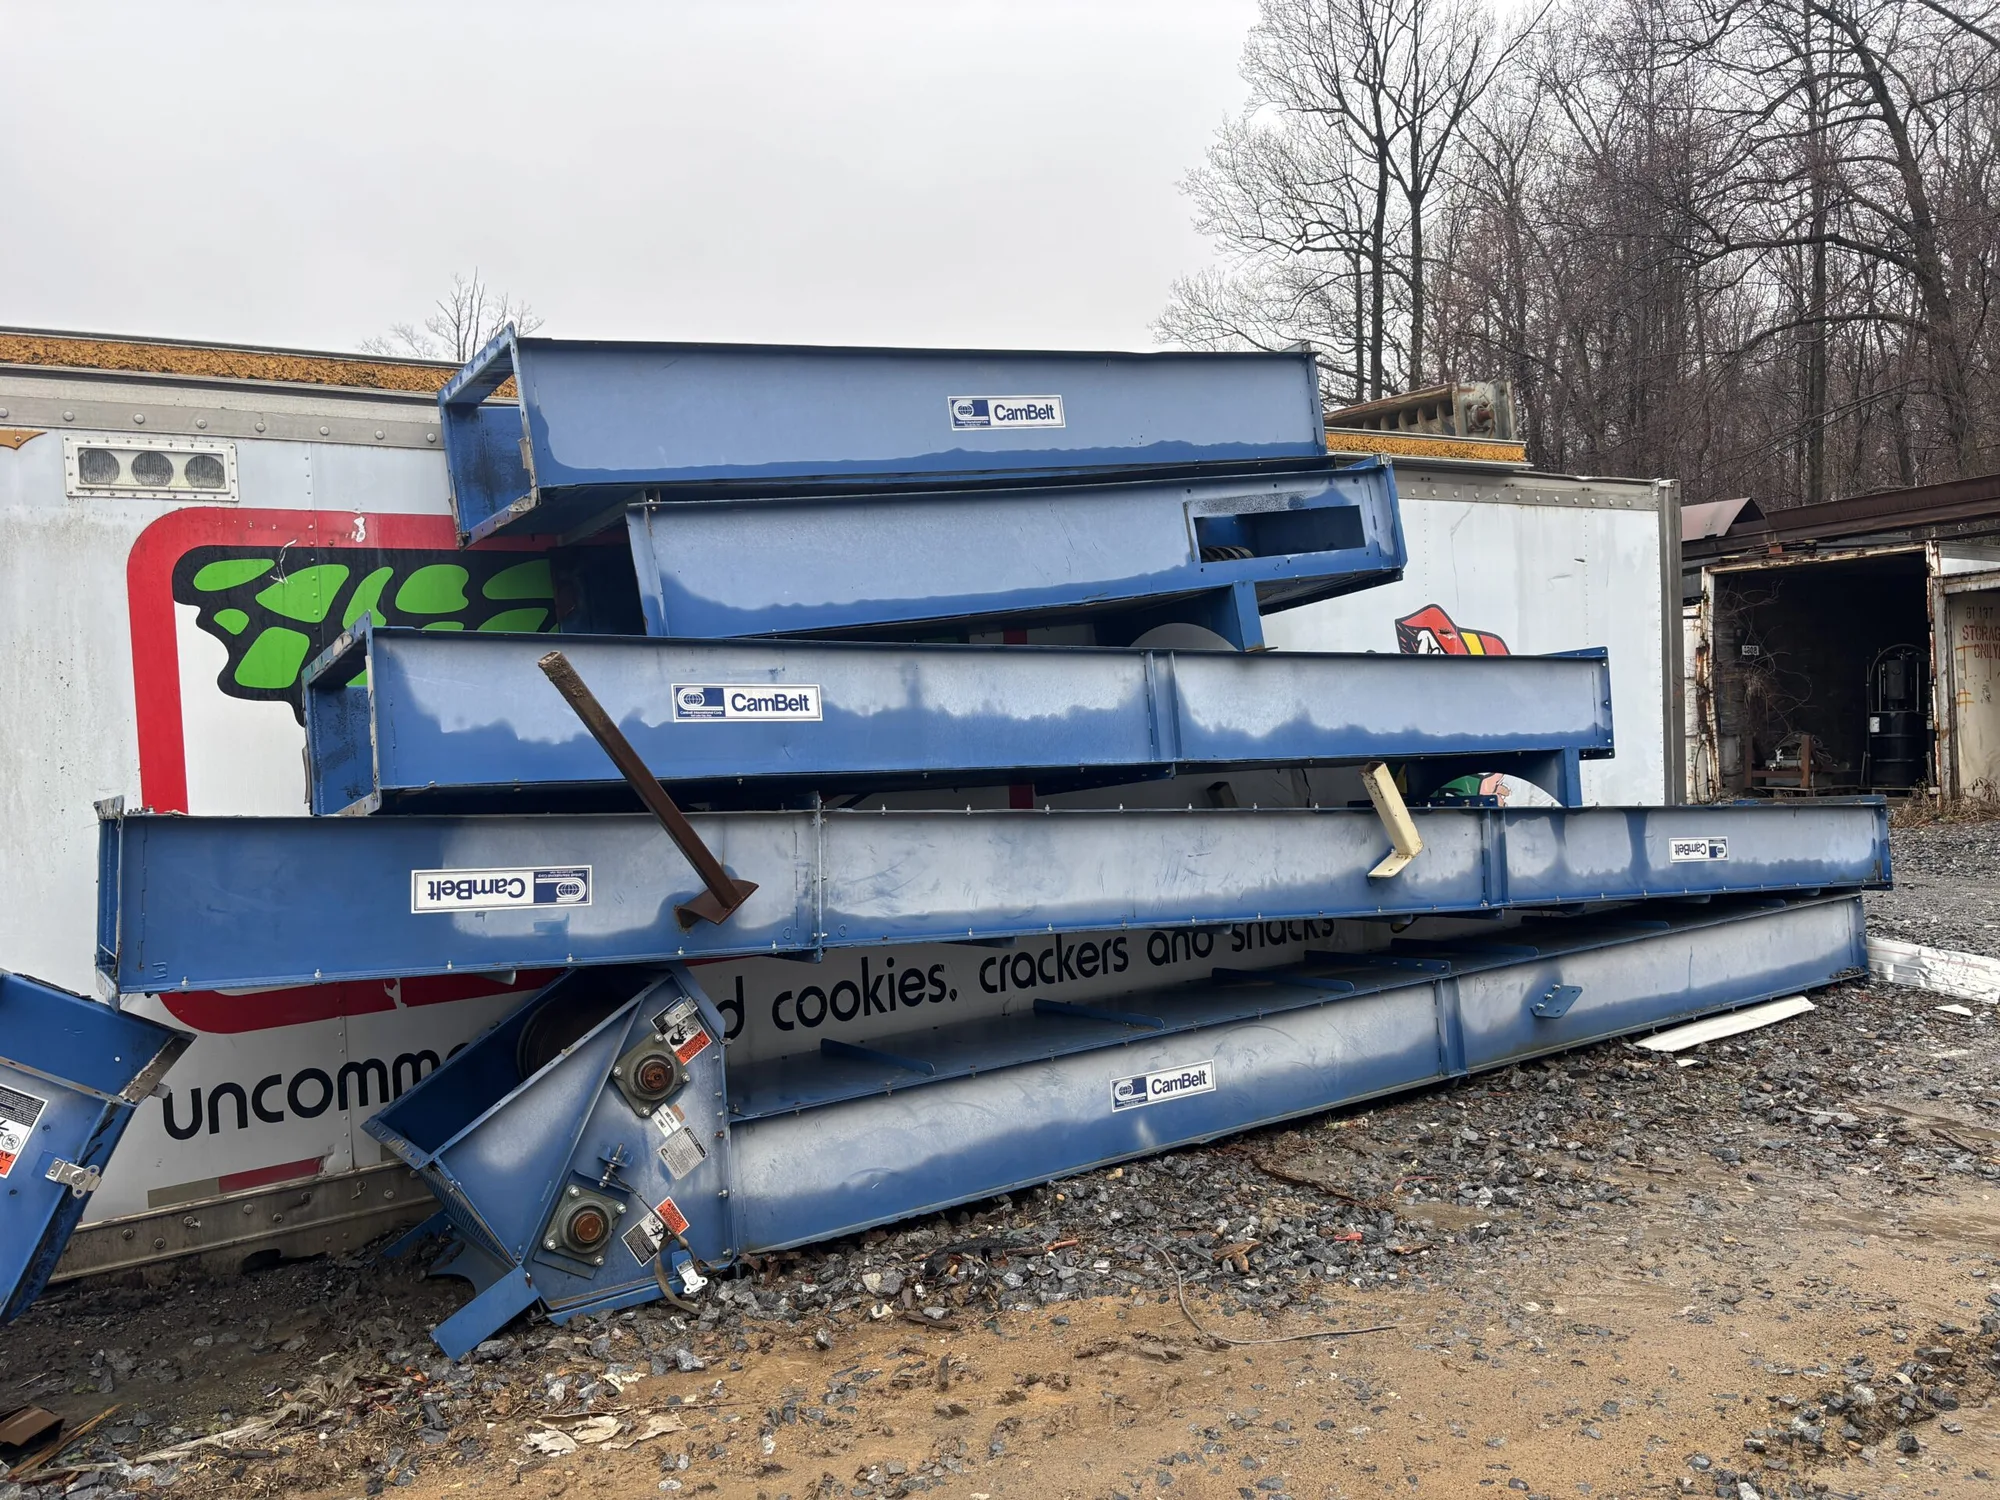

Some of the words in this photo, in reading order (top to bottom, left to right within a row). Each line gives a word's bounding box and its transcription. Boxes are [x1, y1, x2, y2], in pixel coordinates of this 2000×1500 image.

[994, 404, 1055, 421] CamBelt
[731, 693, 810, 712] CamBelt
[1674, 843, 1707, 856] CamBelt
[428, 877, 526, 901] CamBelt
[162, 1042, 470, 1141] uncomm
[979, 934, 1129, 994] crackers
[1231, 918, 1335, 952] snacks
[1151, 1070, 1207, 1095] CamBelt
